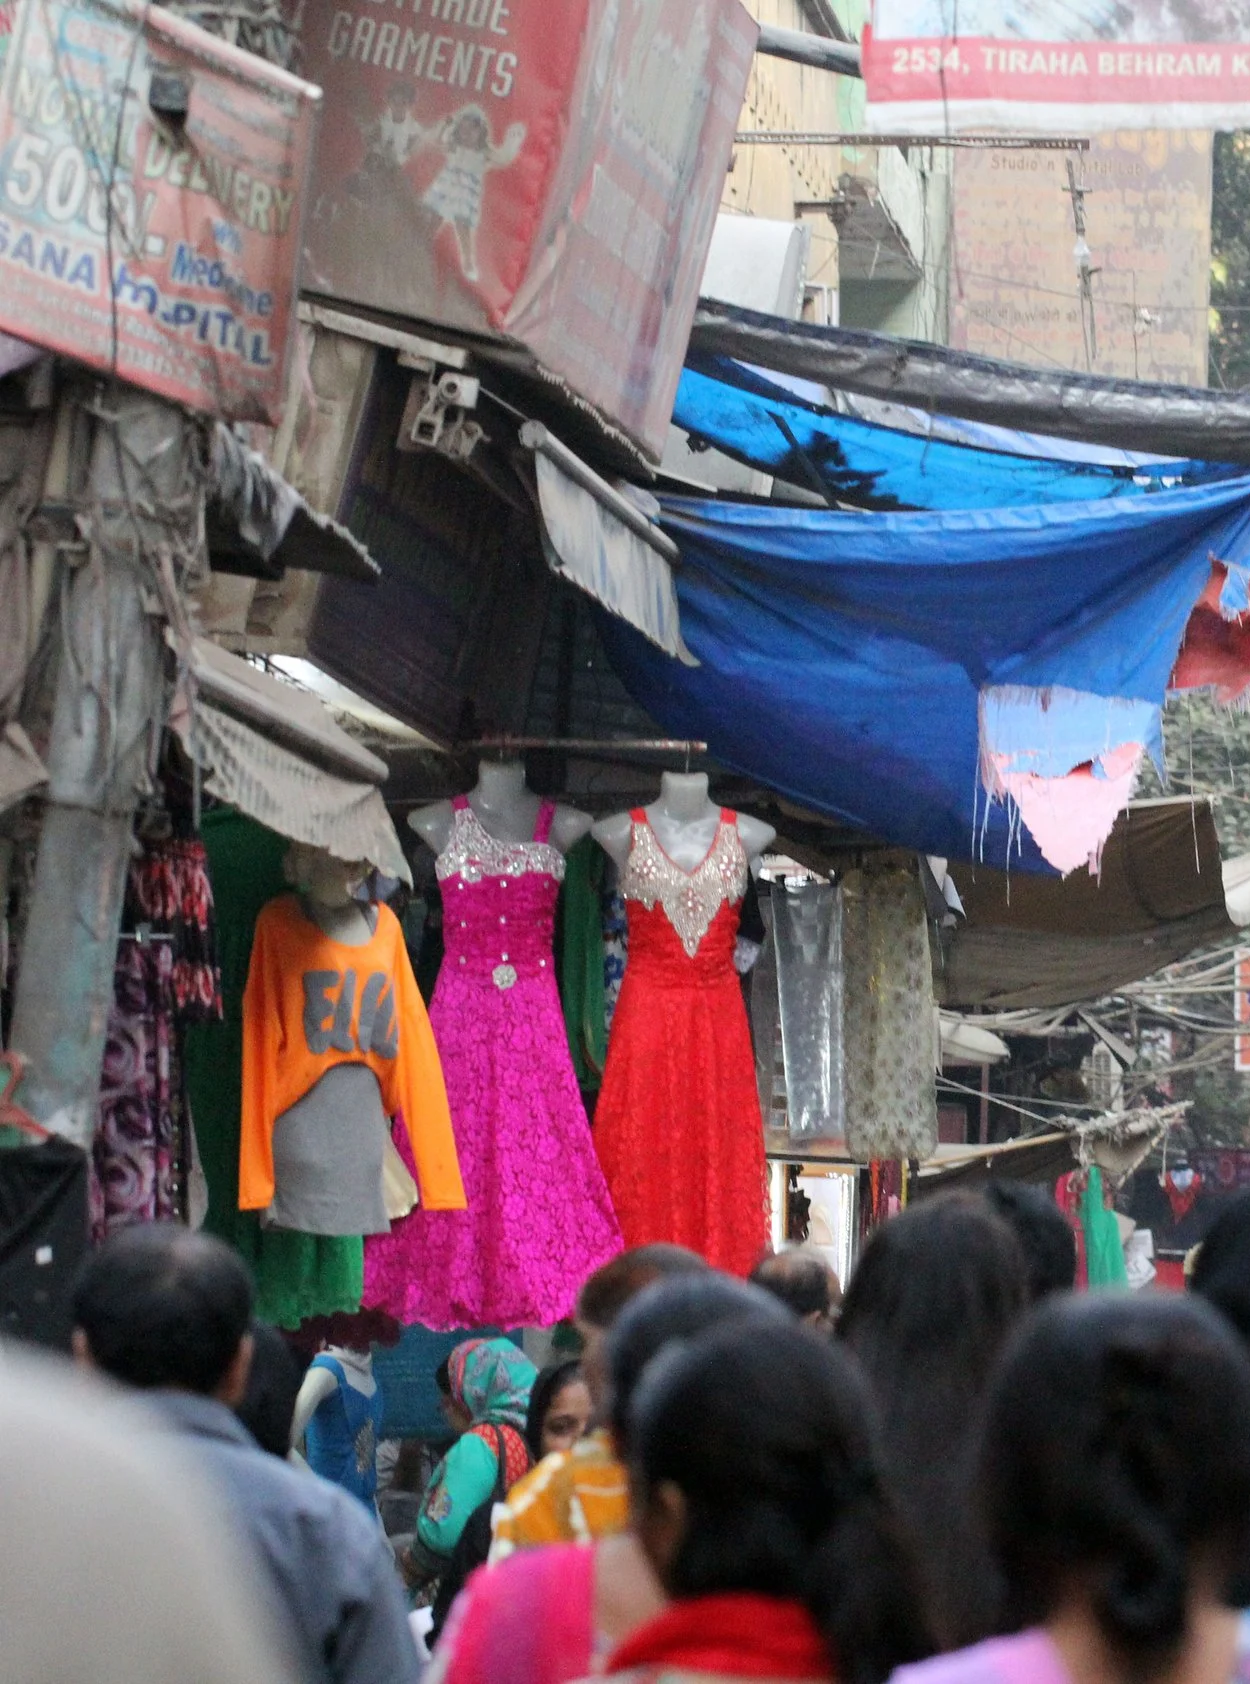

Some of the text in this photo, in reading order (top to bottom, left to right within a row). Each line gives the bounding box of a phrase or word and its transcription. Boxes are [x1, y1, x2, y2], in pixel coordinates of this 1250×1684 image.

[329, 11, 517, 97] GARMENTS
[893, 46, 971, 75] 2534,
[980, 46, 1089, 78] TIRAHA
[1098, 53, 1222, 77] BEHRAM
[991, 155, 1038, 173] Studio
